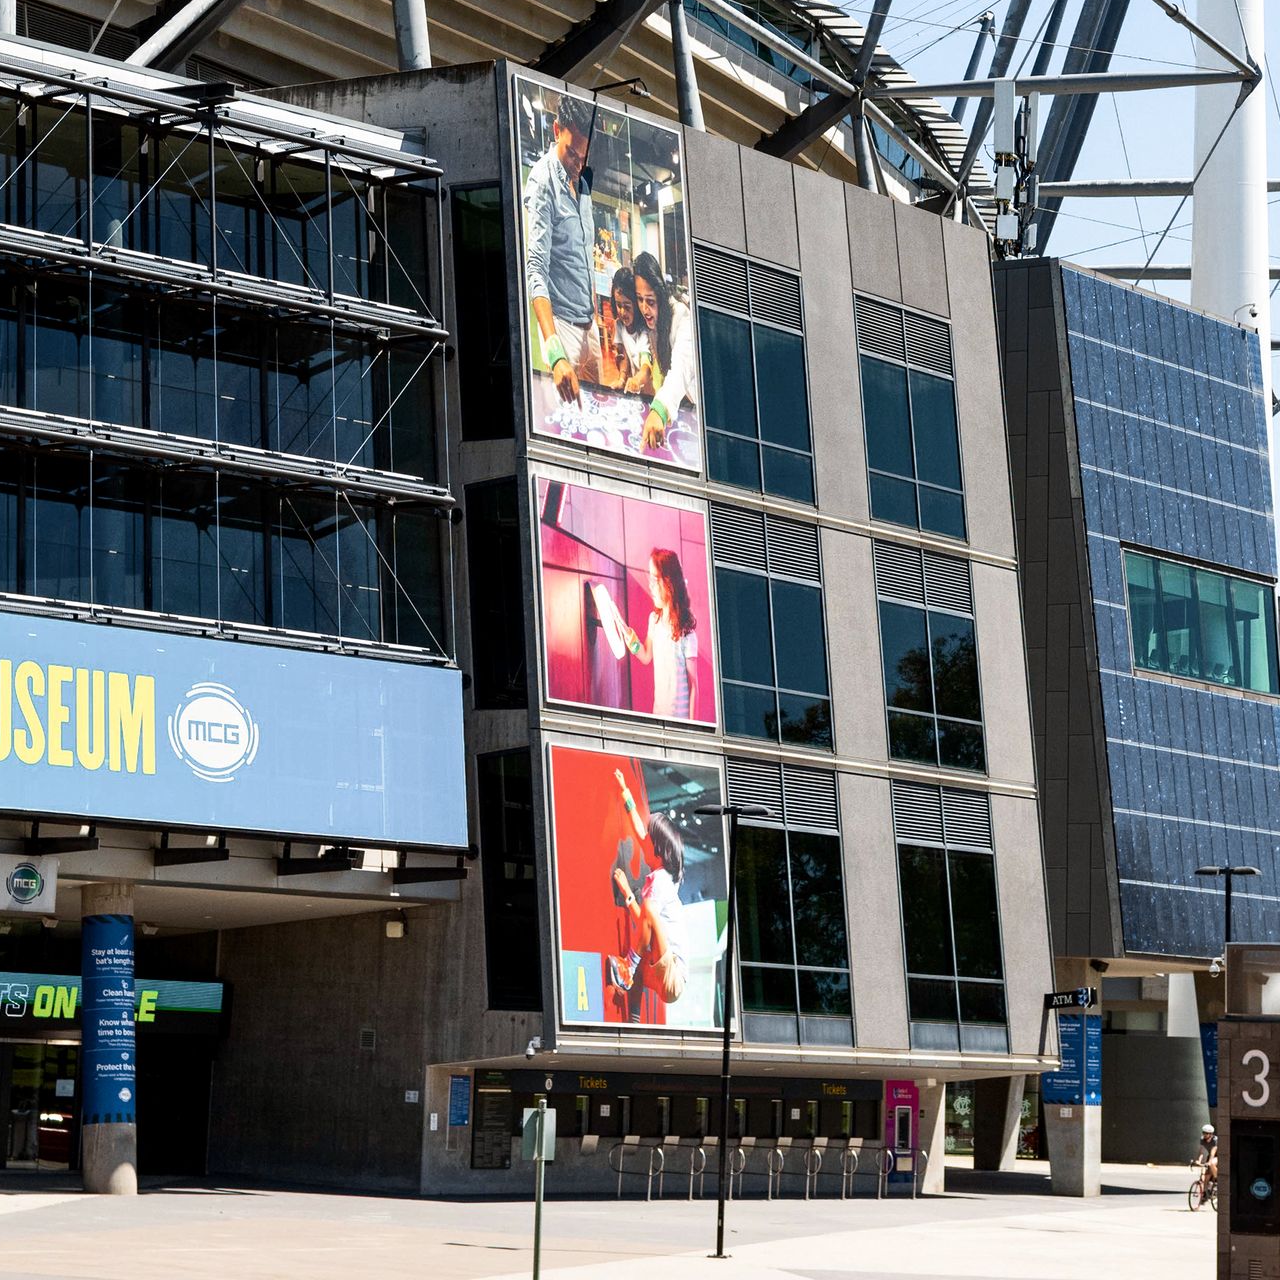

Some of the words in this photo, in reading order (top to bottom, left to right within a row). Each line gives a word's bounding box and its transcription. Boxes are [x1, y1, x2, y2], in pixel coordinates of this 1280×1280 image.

[188, 719, 241, 745] MCG
[13, 878, 37, 889] MCG
[102, 989, 123, 997] Clean
[577, 965, 589, 1012] A
[32, 985, 79, 1019] ON
[1052, 995, 1073, 1006] ATM
[99, 1018, 120, 1027] Know
[97, 1028, 114, 1037] time
[115, 1028, 122, 1036] to
[96, 1063, 122, 1071] Protect
[579, 1076, 608, 1089] Tickets
[1242, 1049, 1270, 1107] 3
[822, 1083, 847, 1095] Tickets
